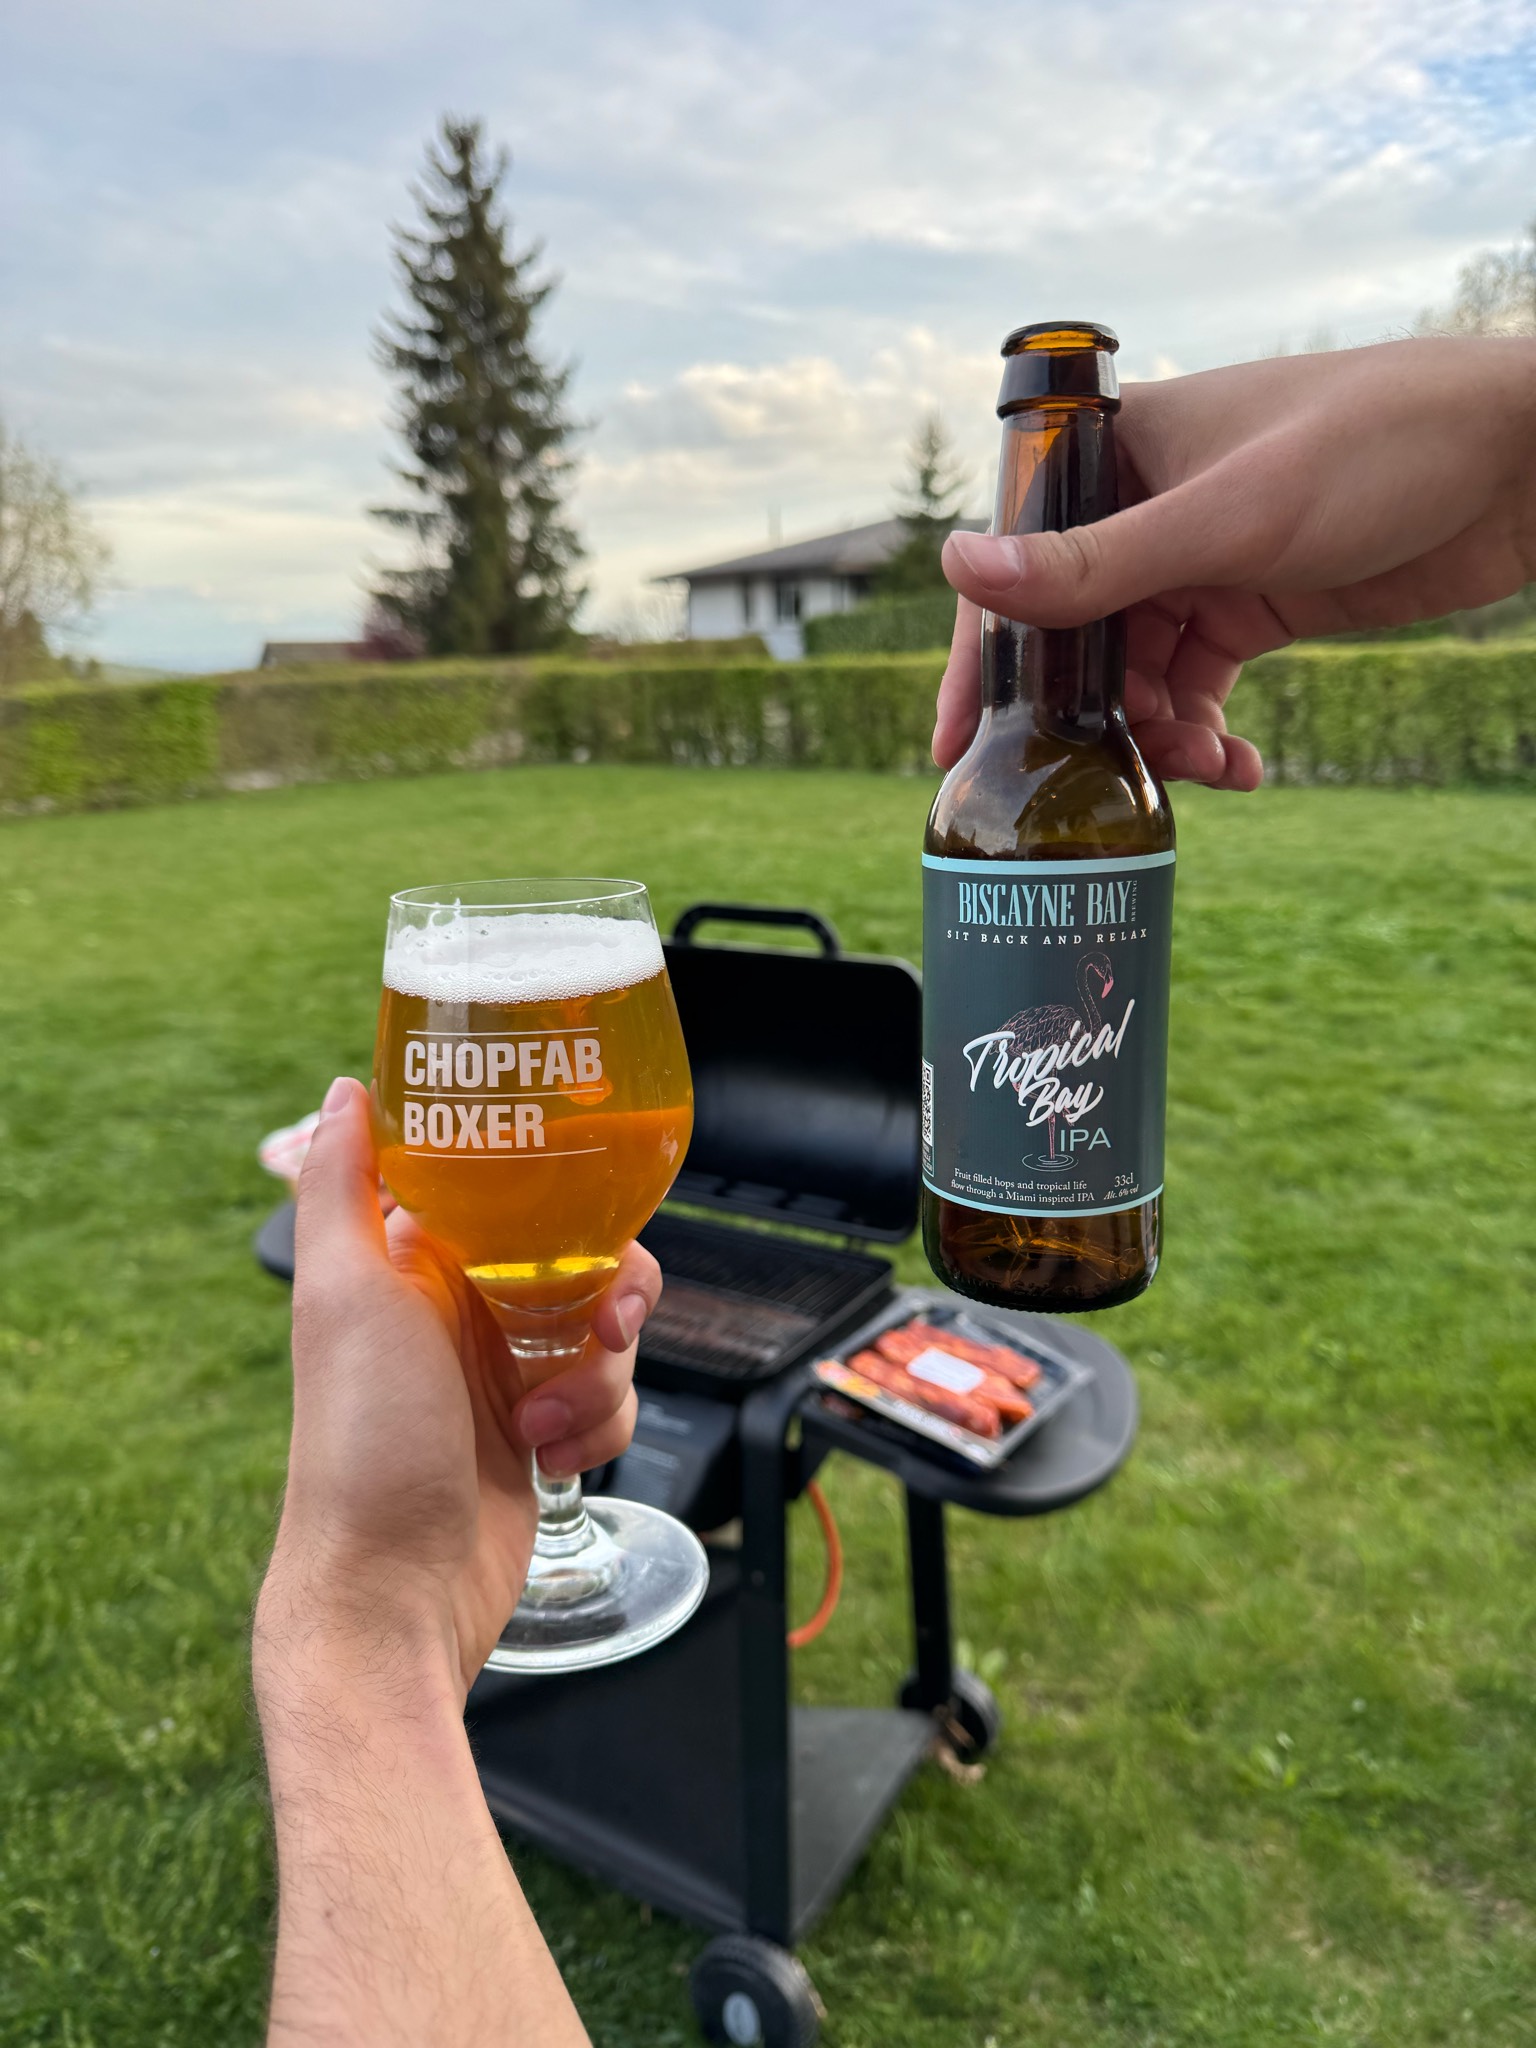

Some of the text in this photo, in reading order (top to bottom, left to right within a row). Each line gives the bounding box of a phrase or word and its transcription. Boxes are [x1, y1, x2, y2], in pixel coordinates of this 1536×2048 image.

[957, 880, 1132, 927] BISCAYNE BAY
[1130, 880, 1138, 922] BREWING
[947, 928, 1147, 945] SIT BACK AND RELAX
[404, 1038, 603, 1088] CHOPFAB
[962, 998, 1136, 1107] Tropical
[1025, 1076, 1104, 1127] Bay
[403, 1101, 546, 1149] BOXER
[1059, 1127, 1112, 1152] IPA
[951, 1179, 1095, 1206] flow through a Miami inspired IPA
[954, 1167, 1088, 1193] Fruit filled hops and tropical life
[1103, 1190, 1118, 1200] Alc.
[1129, 1183, 1140, 1195] vol
[1114, 1172, 1134, 1188] 33cl
